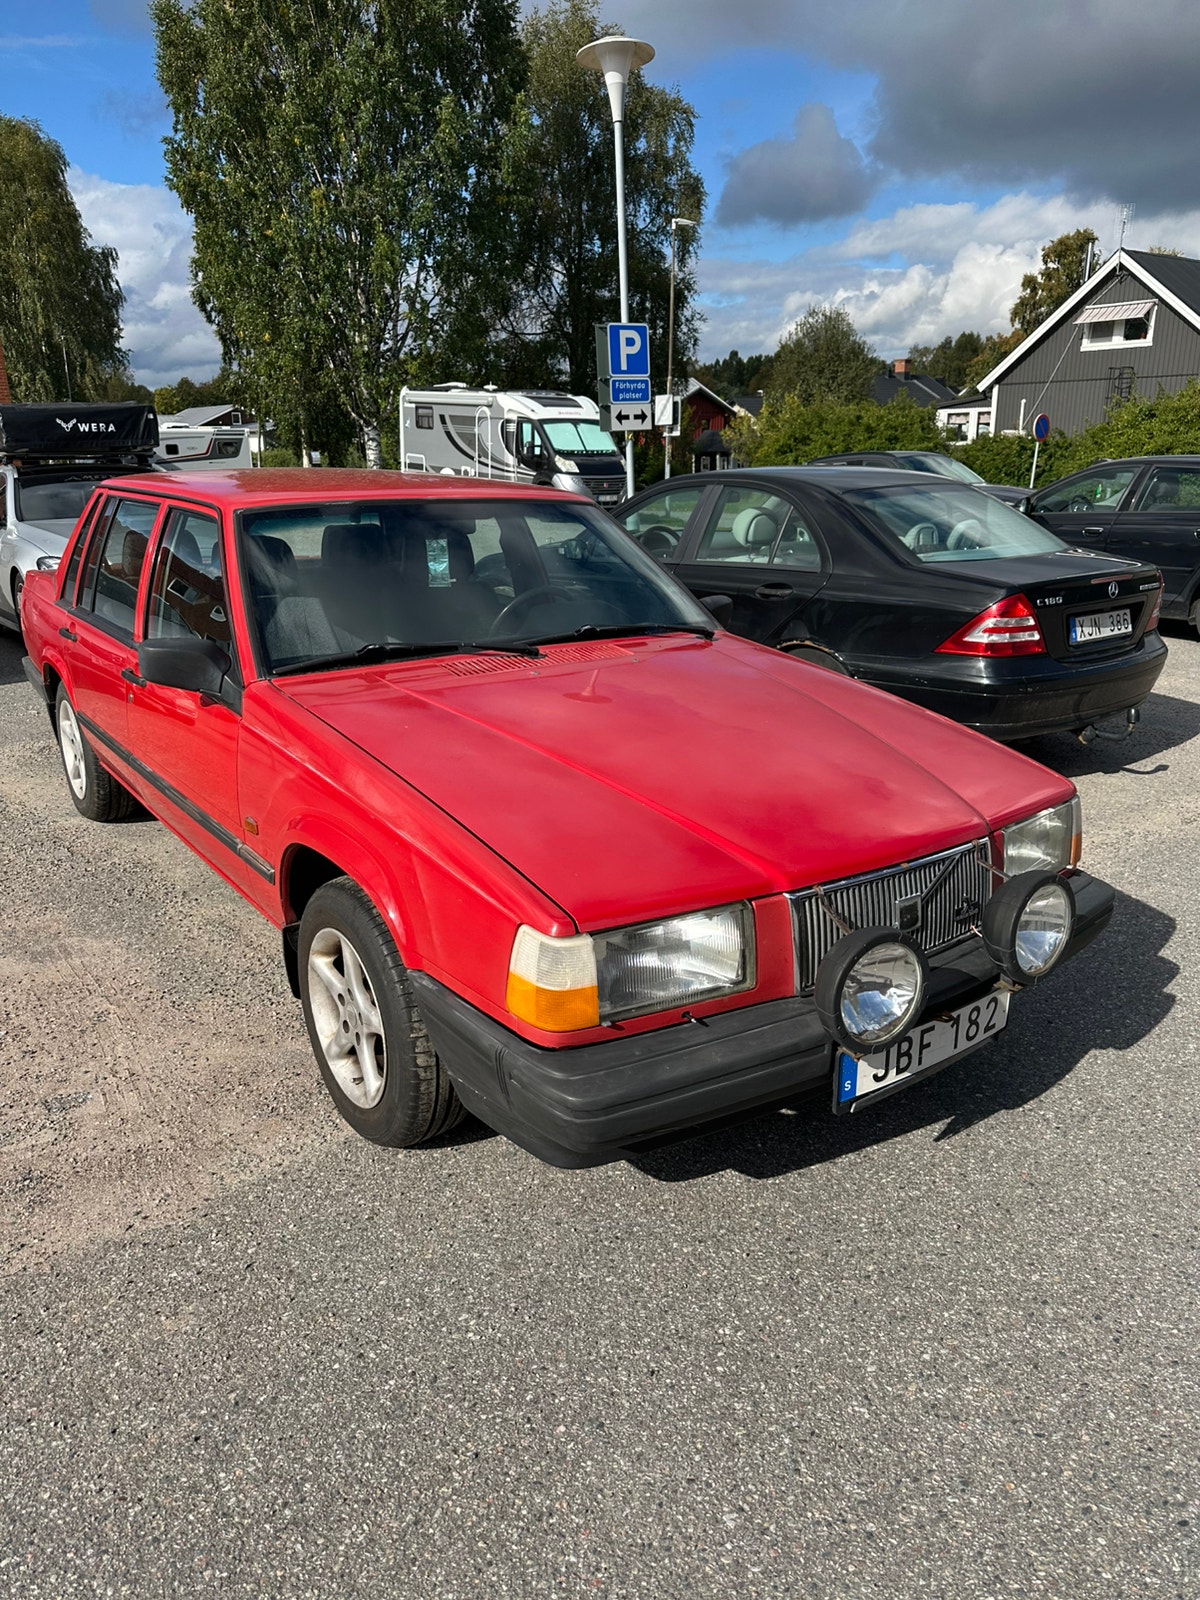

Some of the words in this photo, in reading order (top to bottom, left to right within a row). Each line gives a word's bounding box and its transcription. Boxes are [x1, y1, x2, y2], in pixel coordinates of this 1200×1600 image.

[619, 329, 641, 370] P
[615, 381, 646, 390] Förhyrda
[619, 391, 643, 400] platser
[77, 422, 116, 432] WERA
[1077, 618, 1102, 639] XJN
[1108, 612, 1130, 633] 386
[872, 1025, 936, 1083] JBF
[950, 996, 999, 1050] 182
[844, 1080, 852, 1091] S
